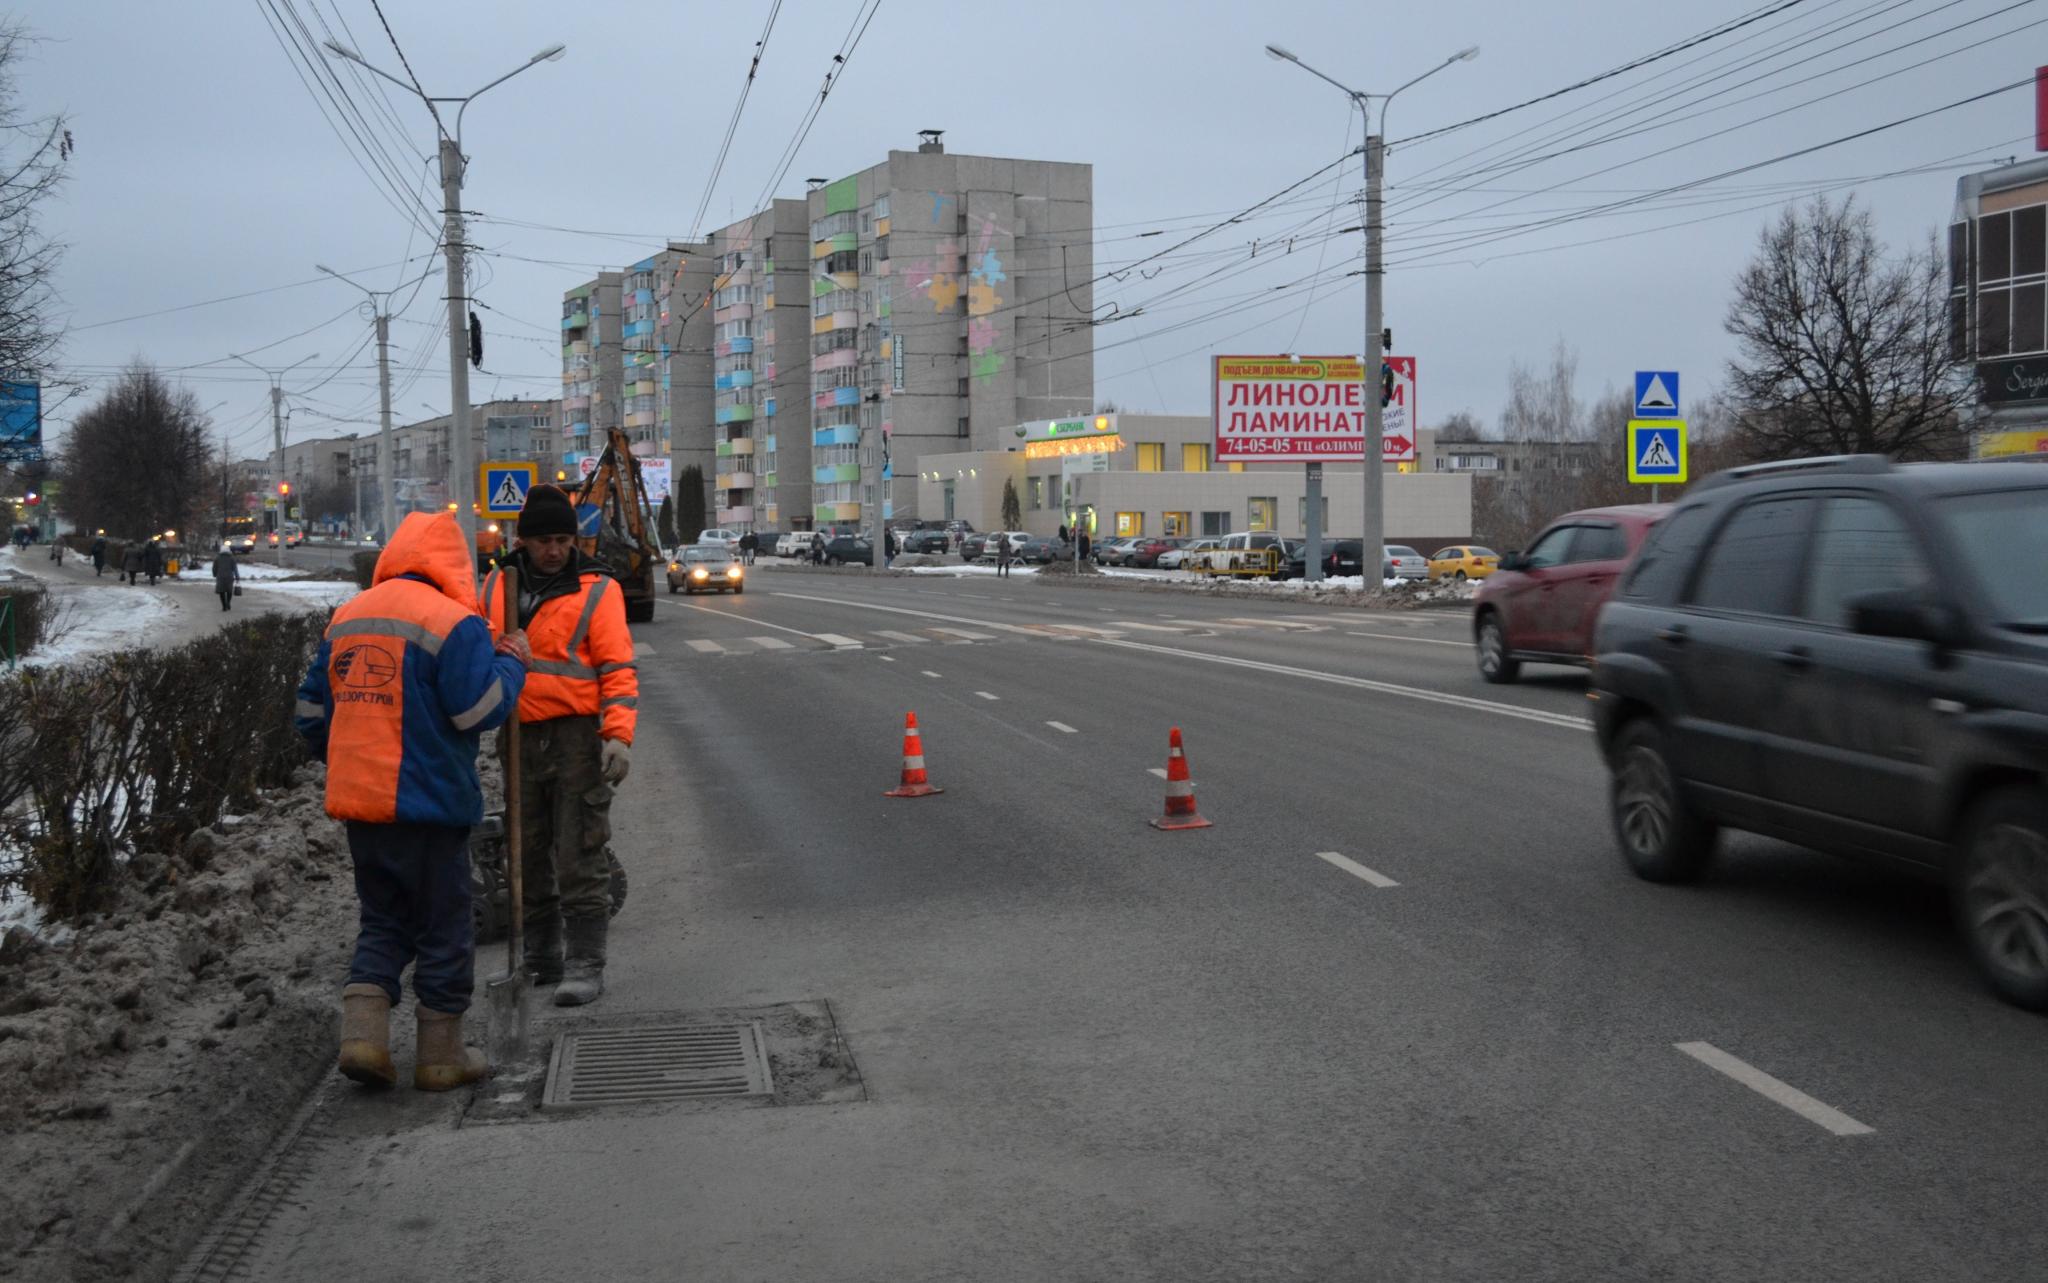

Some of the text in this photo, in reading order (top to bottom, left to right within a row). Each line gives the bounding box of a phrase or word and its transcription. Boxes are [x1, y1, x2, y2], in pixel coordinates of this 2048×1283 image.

[1223, 364, 1320, 377] ПОДЪЕМ ДО КВАРТИРЫ
[1228, 384, 1404, 406] ЛИНОЛЕМ
[1228, 412, 1365, 433] ЛАМИНАТ
[1226, 438, 1290, 453] 74-05-05
[1295, 440, 1312, 453] ТЦ
